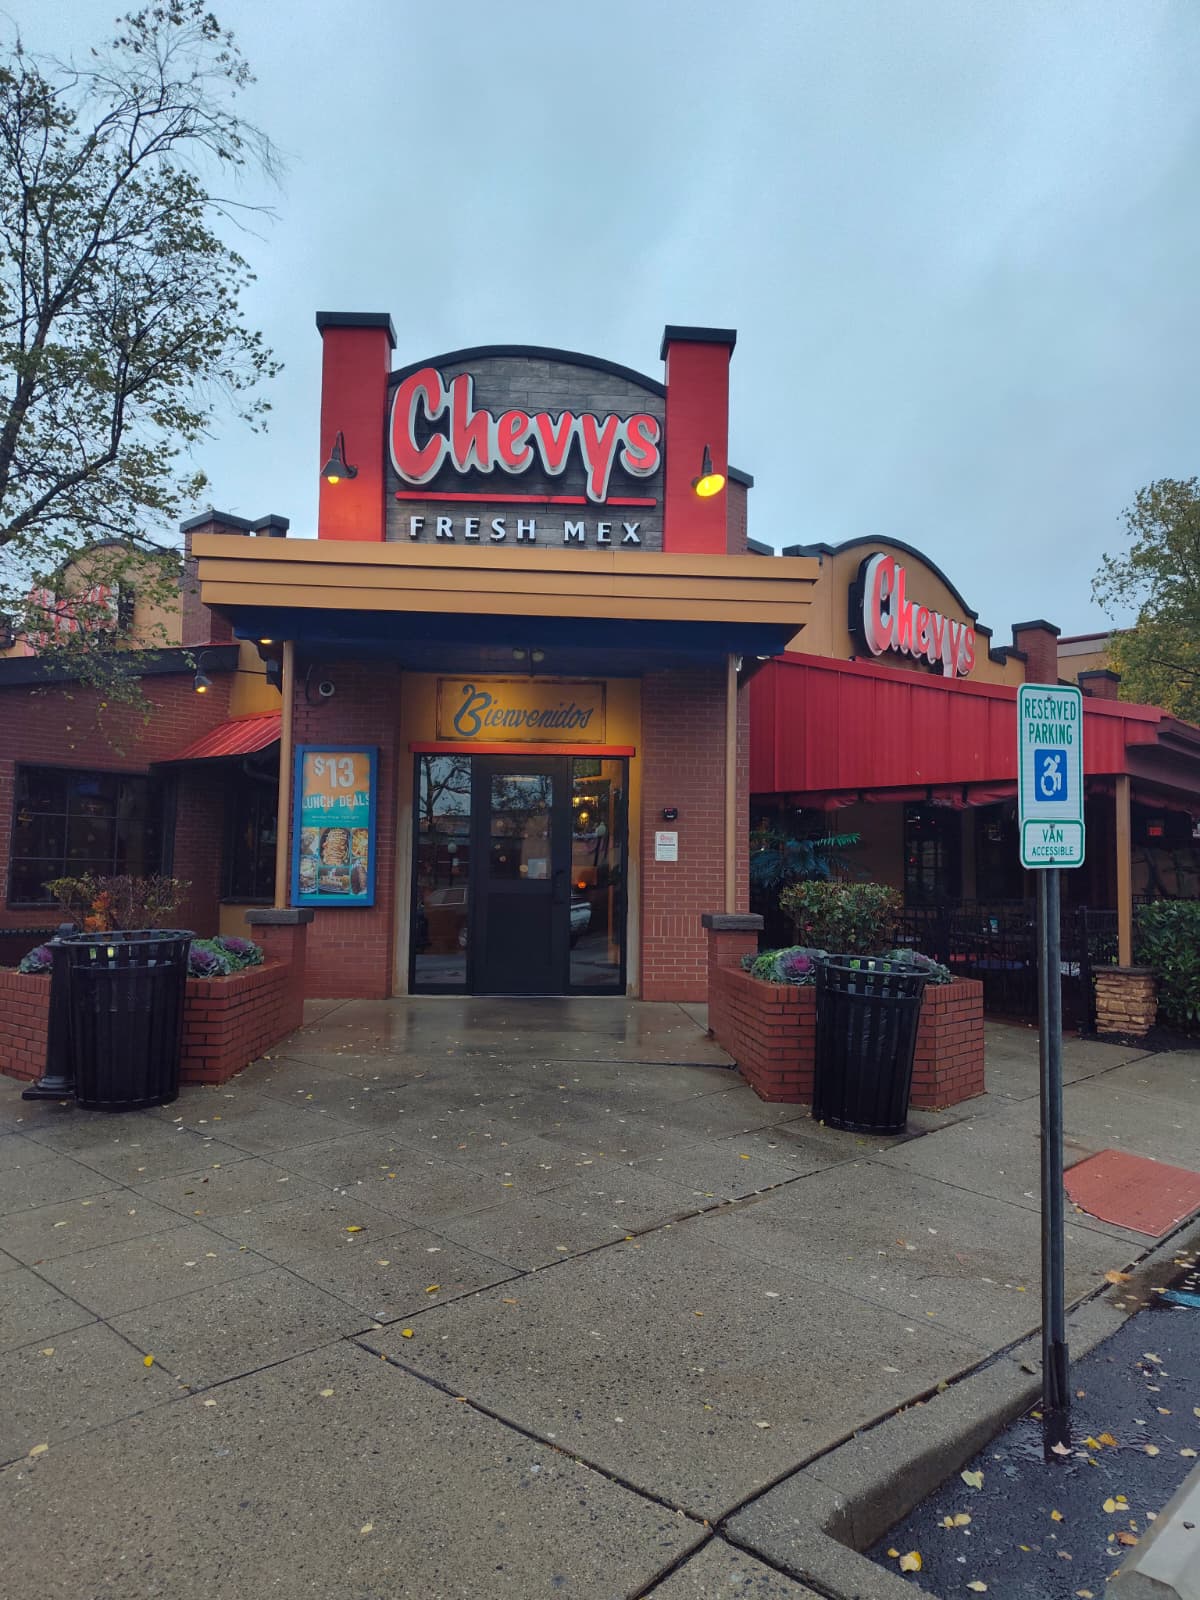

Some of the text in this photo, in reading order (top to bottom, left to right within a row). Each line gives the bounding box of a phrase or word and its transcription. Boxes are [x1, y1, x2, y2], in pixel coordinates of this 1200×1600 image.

[390, 366, 661, 503] Chevys
[410, 516, 641, 543] FRESH MEX
[863, 552, 976, 679] Chevys
[453, 683, 594, 737] Bienvenidos
[1024, 698, 1077, 721] RESERVED
[1028, 722, 1073, 745] PARKING
[313, 756, 355, 788] $13
[1042, 829, 1064, 843] VAN
[1031, 846, 1074, 857] ACCESSIBLE
